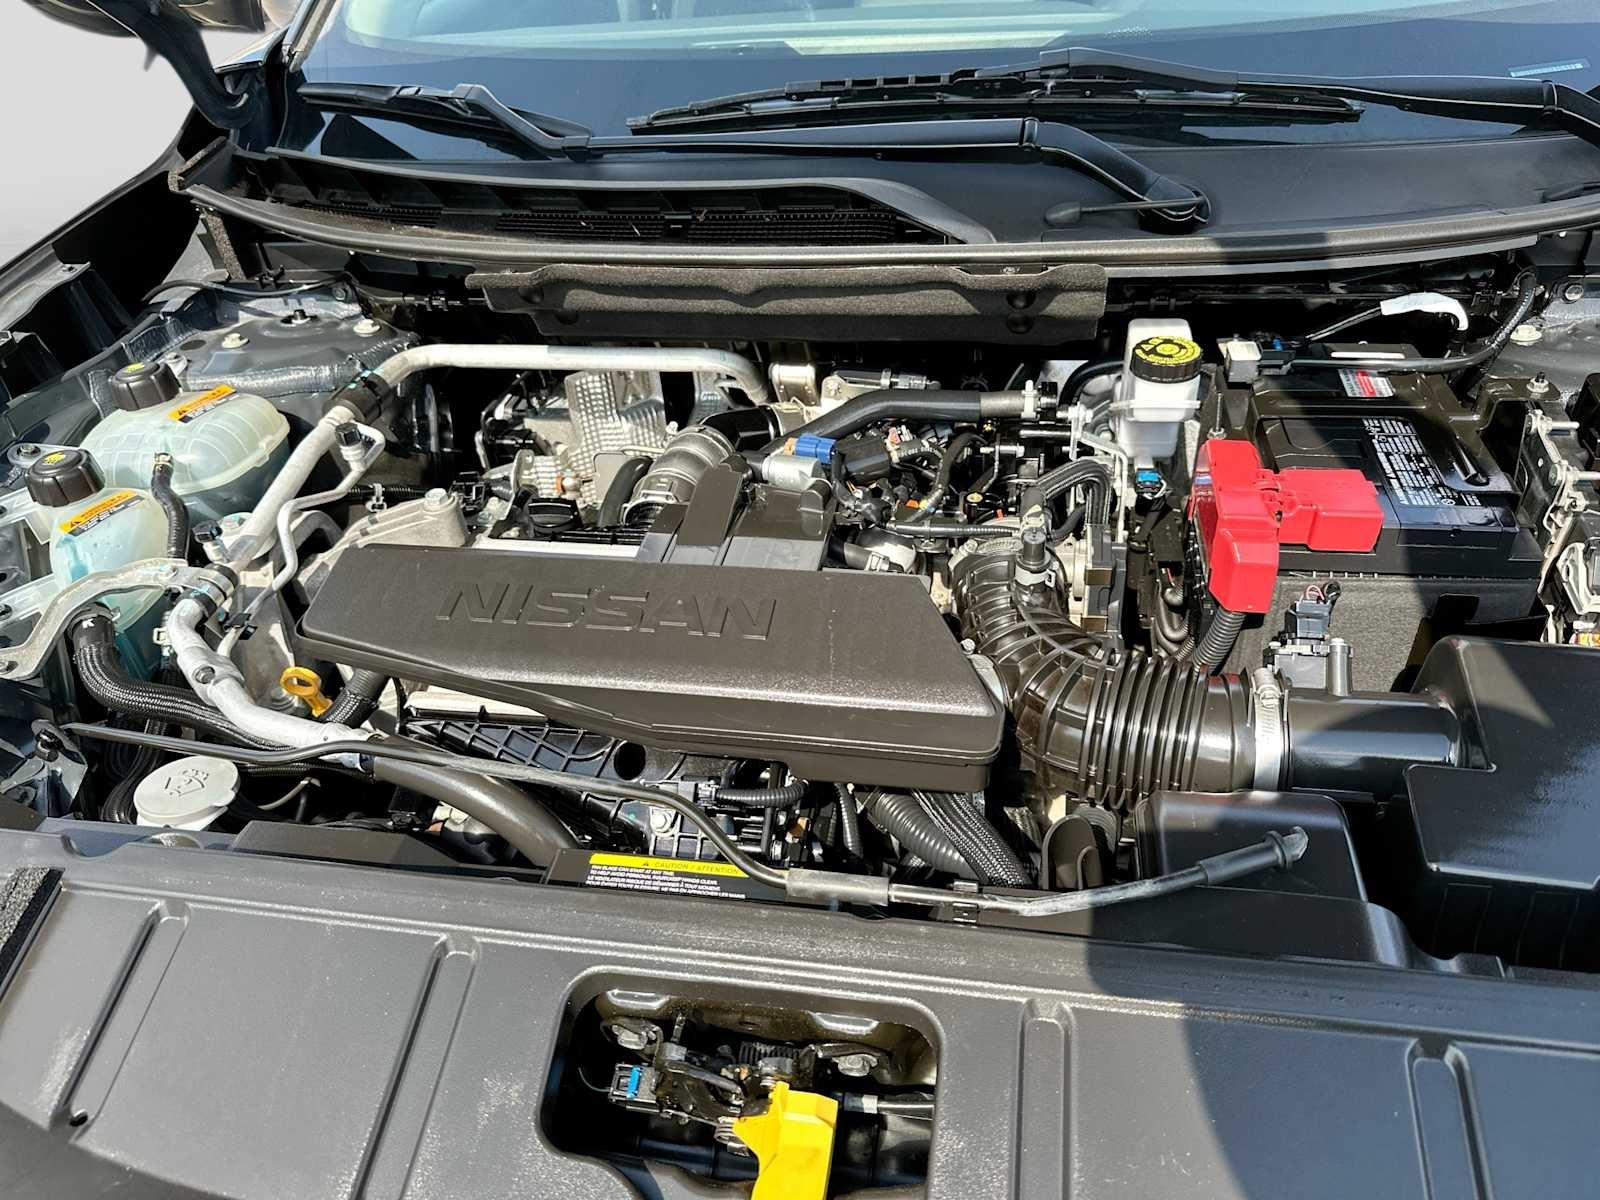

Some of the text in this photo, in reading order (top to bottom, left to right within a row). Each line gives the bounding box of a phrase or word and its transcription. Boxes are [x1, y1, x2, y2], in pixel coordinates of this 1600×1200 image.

[435, 583, 776, 641] NISSAN
[655, 862, 688, 870] CAUTION
[697, 865, 739, 875] ATTENTION
